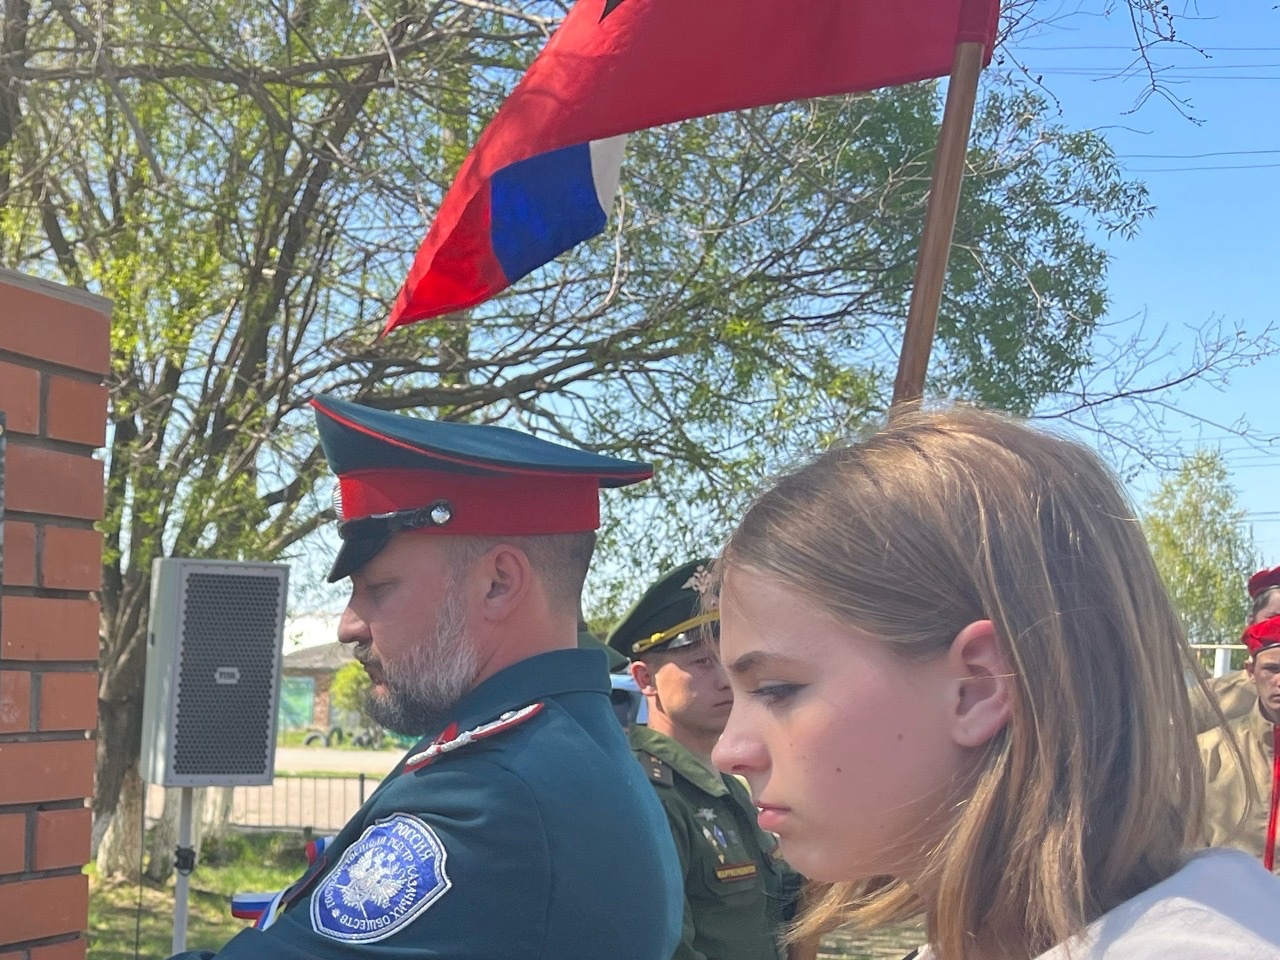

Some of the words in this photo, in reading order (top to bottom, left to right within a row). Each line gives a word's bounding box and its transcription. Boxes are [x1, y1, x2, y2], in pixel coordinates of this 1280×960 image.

[387, 837, 414, 862] РЕЕСТР
[392, 821, 435, 862] РОССИЯ
[389, 863, 419, 920] КАЗАЧЬИХ
[340, 914, 391, 931] ОБЩЕСТВ
